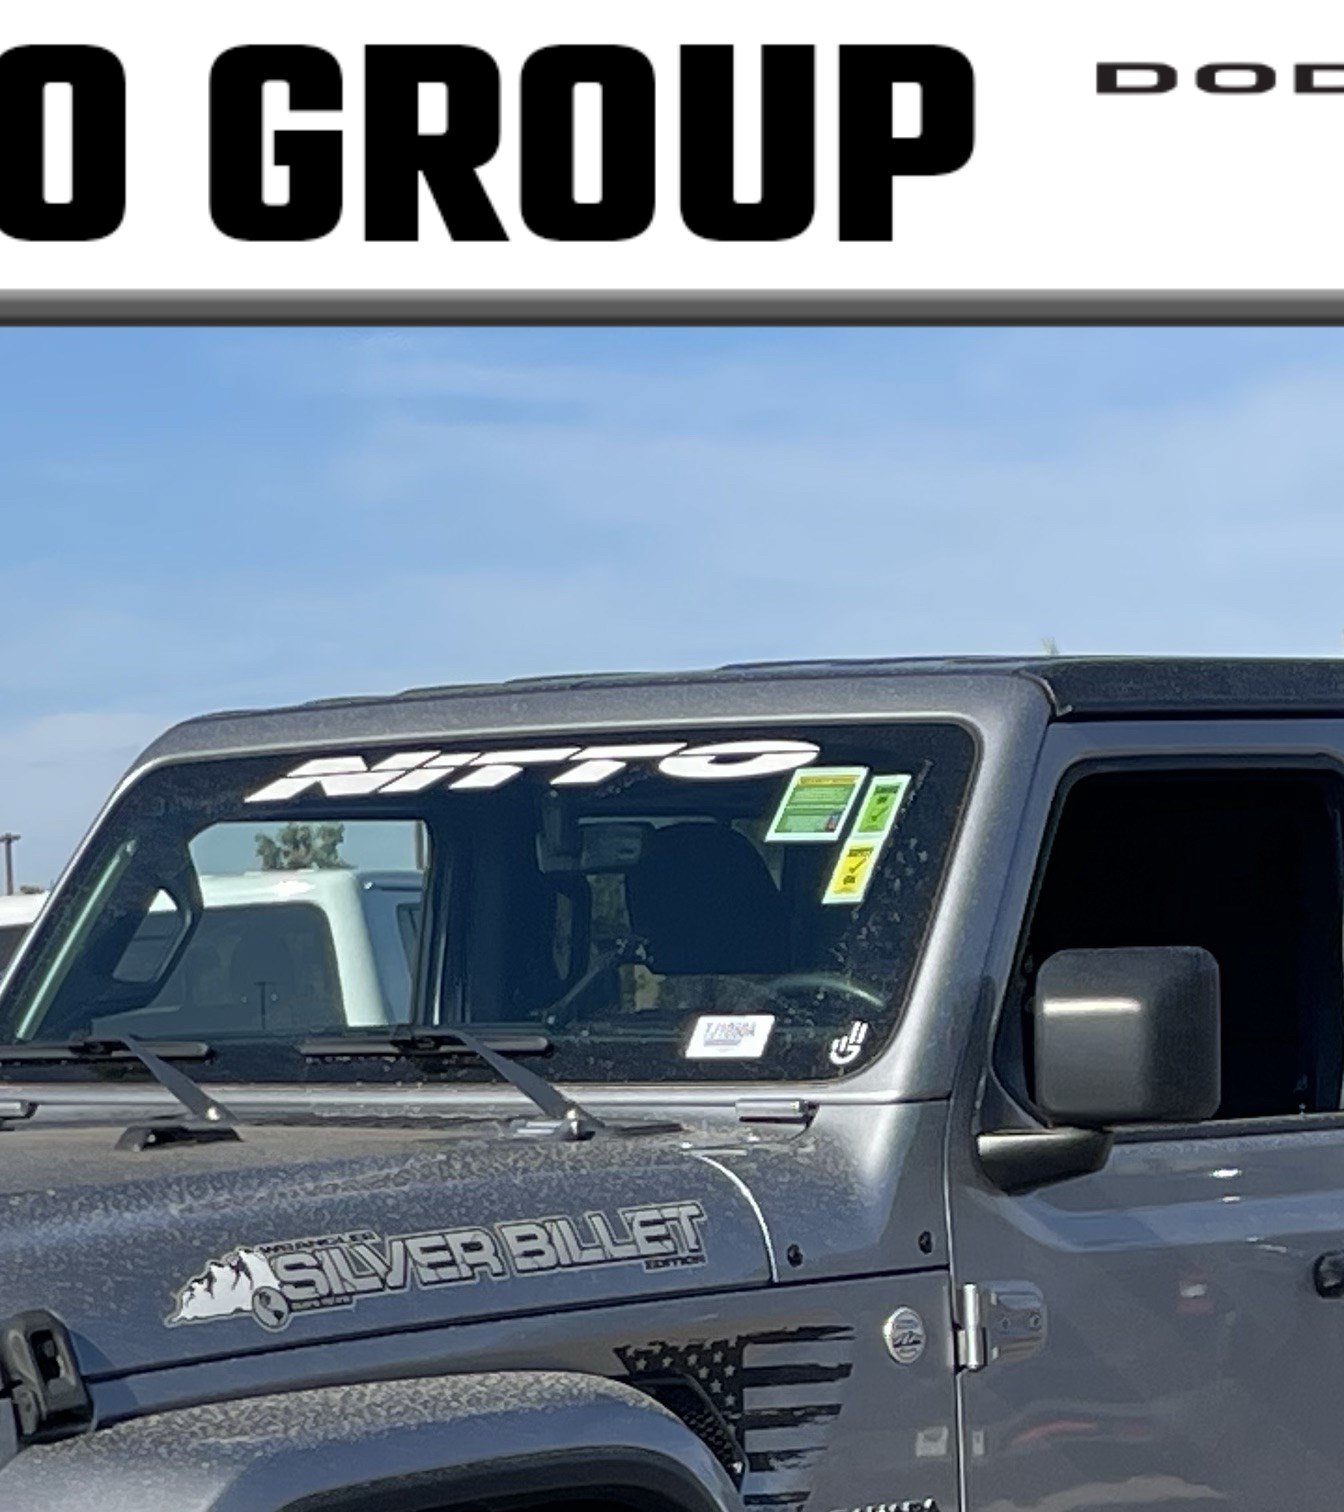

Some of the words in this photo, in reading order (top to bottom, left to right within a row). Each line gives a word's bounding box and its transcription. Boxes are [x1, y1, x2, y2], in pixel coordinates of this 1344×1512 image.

[244, 740, 821, 803] NITTO
[268, 1227, 506, 1301] SILVER
[501, 1203, 705, 1273] BILLET
